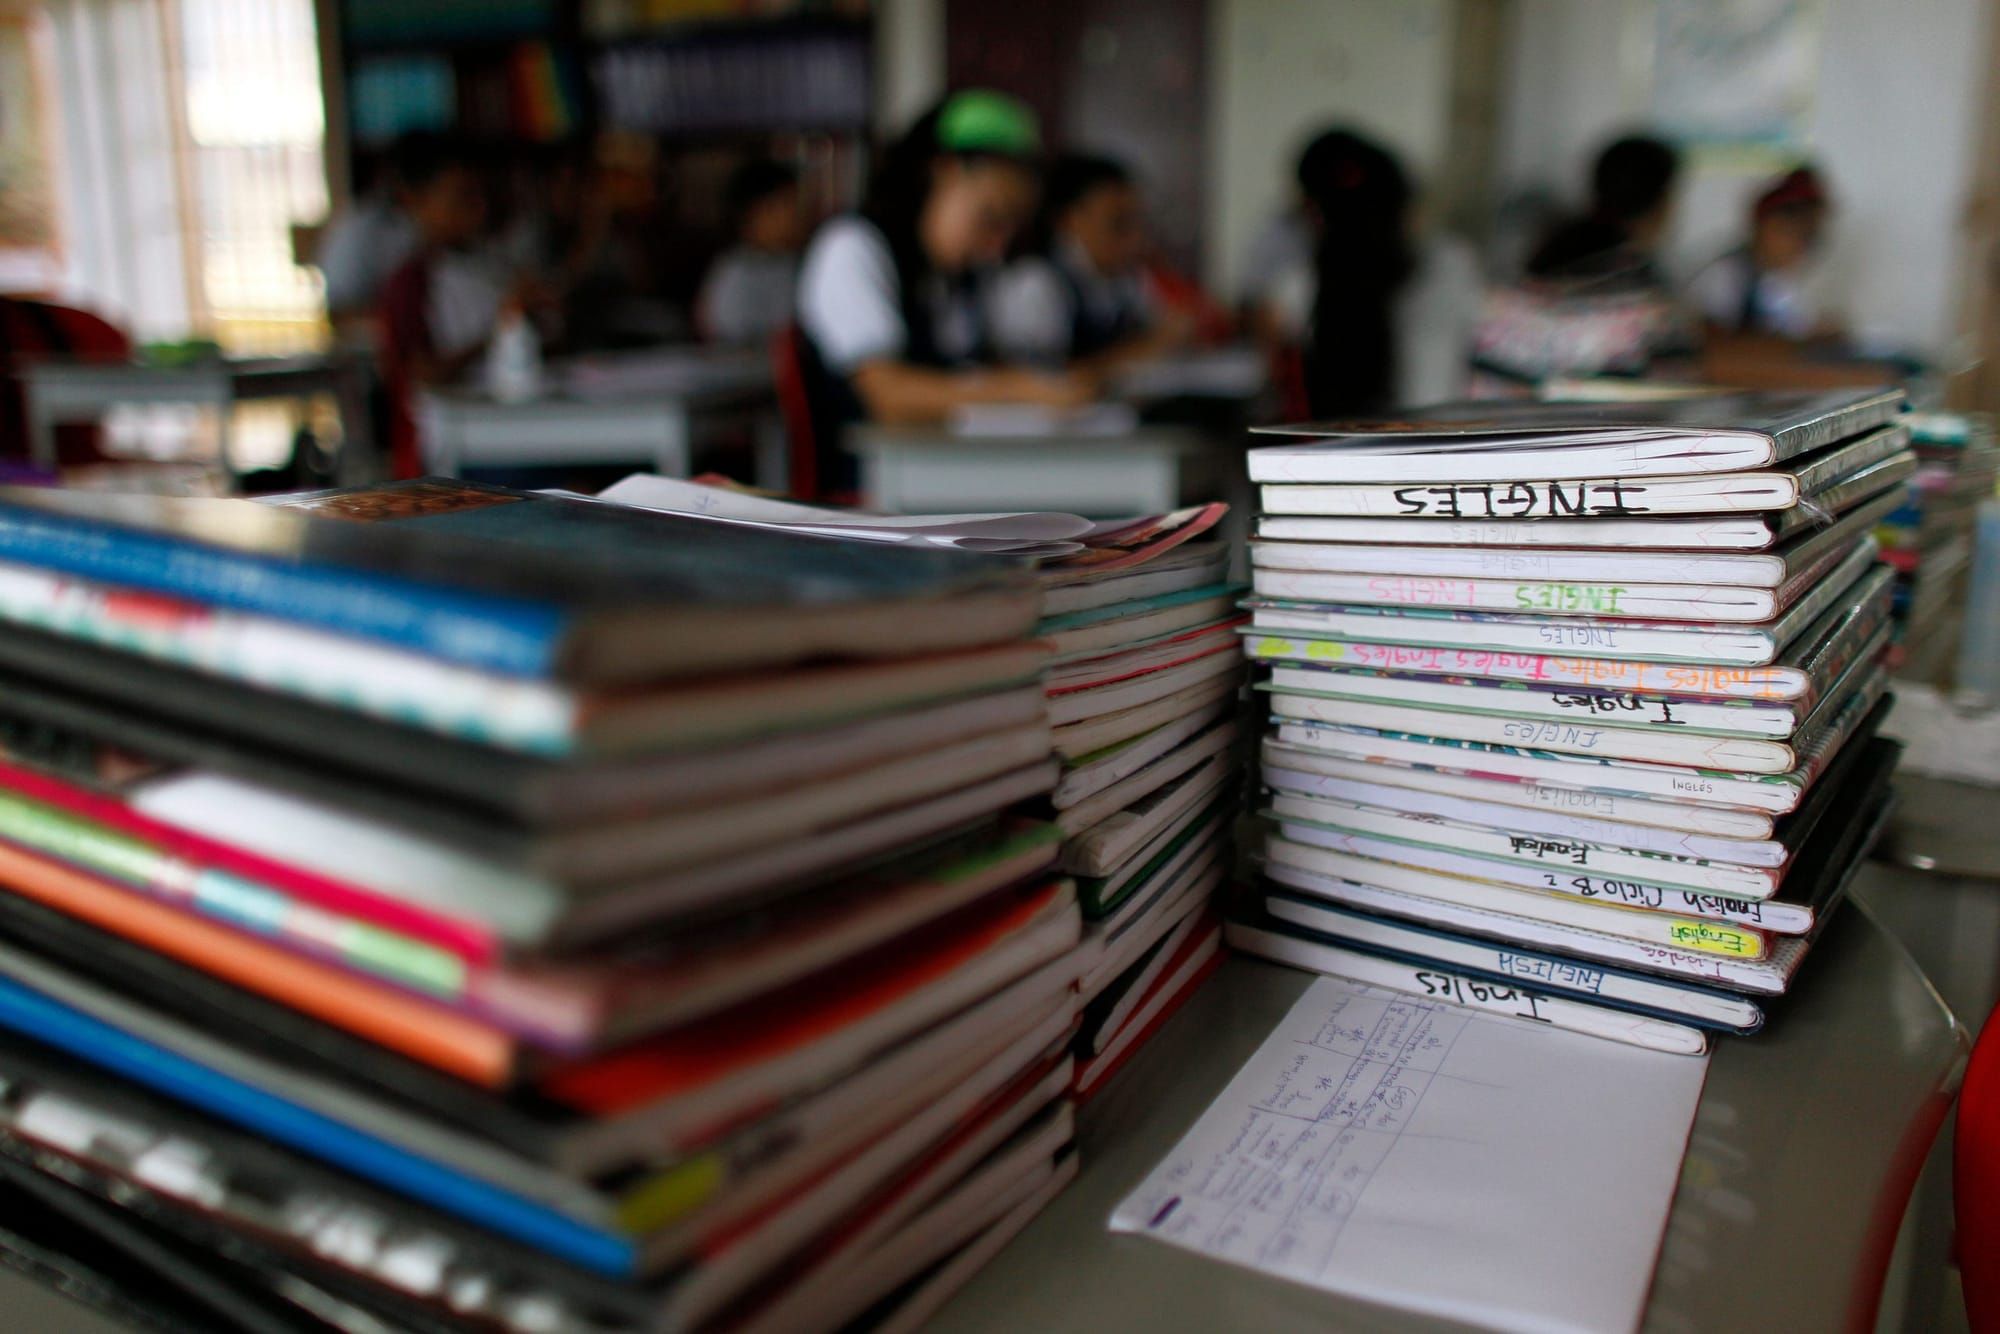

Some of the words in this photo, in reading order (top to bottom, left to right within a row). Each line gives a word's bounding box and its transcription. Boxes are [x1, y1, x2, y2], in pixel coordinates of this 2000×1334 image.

[1392, 480, 1650, 518] INGLES
[1538, 625, 1618, 649] INGLES
[1570, 877, 1599, 897] B
[1602, 880, 1663, 908] Ciclo
[1669, 923, 1747, 953] English
[1414, 972, 1553, 1024] Ingles
